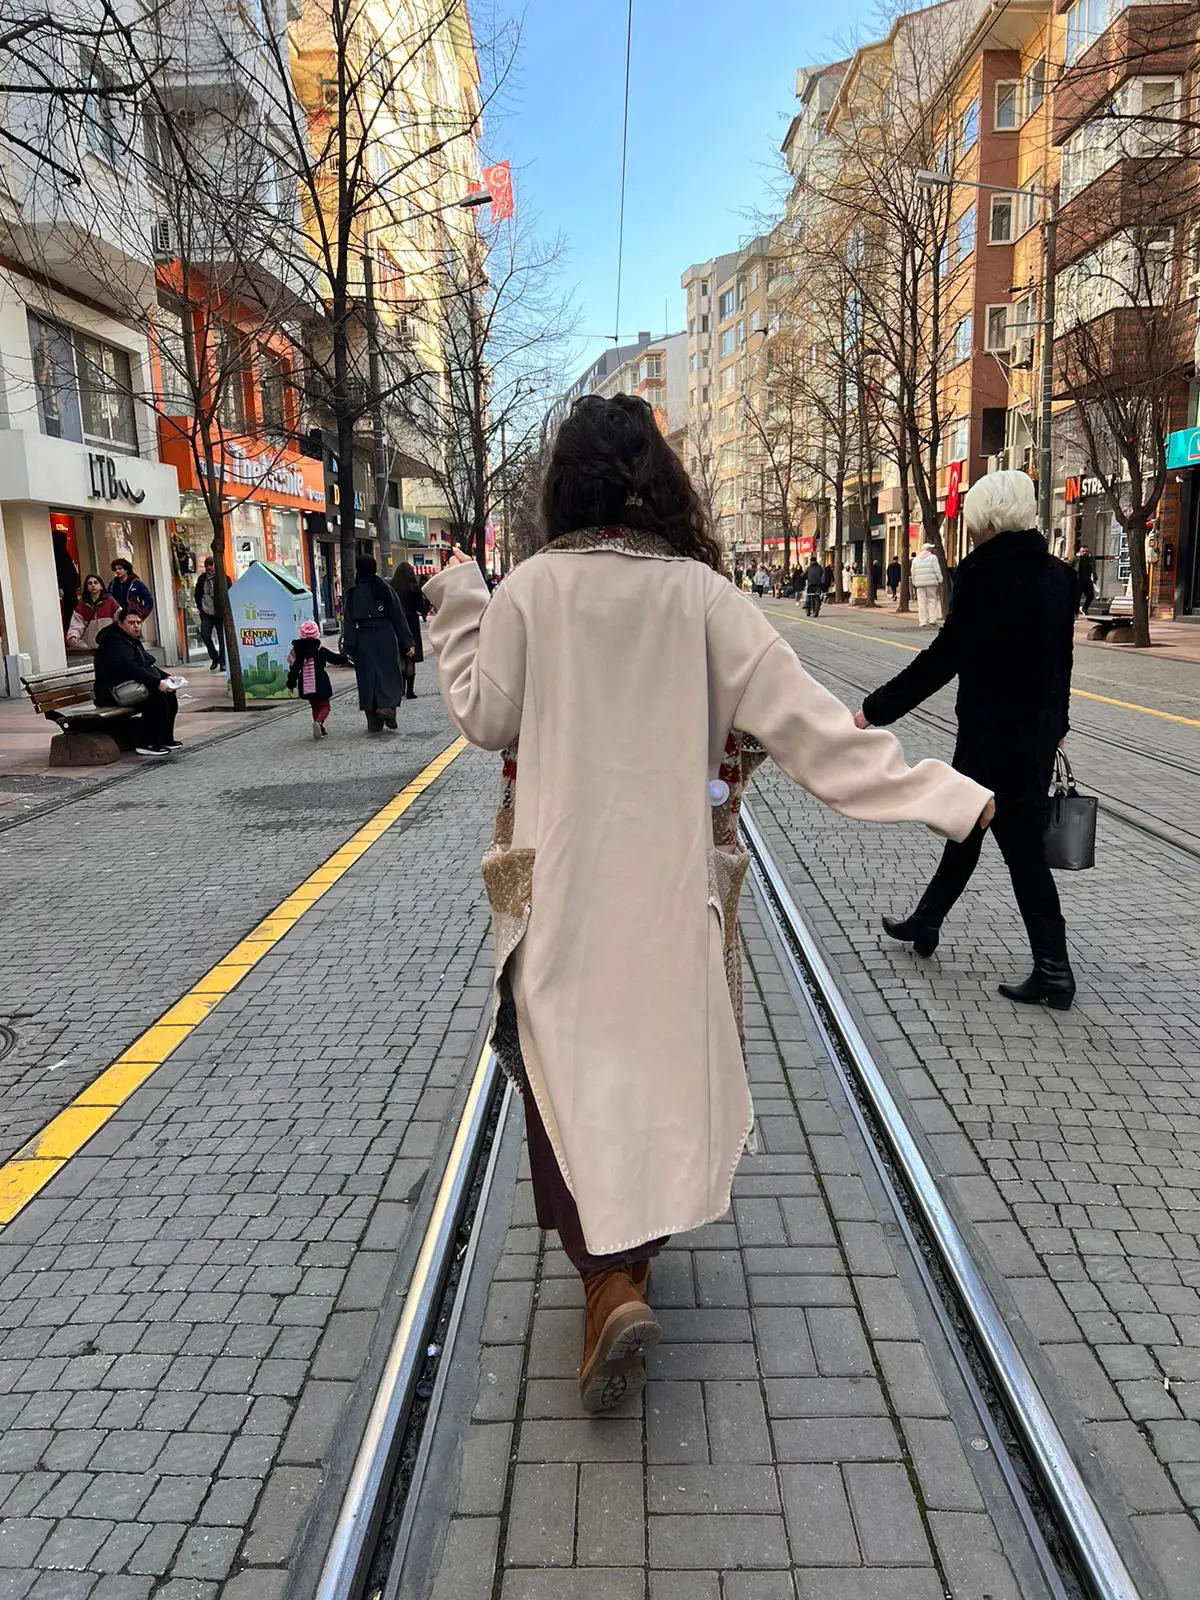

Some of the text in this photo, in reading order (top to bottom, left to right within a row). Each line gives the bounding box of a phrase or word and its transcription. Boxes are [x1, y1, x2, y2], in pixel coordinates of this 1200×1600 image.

[88, 452, 118, 499] LTB
[1065, 474, 1113, 504] IN STRET
